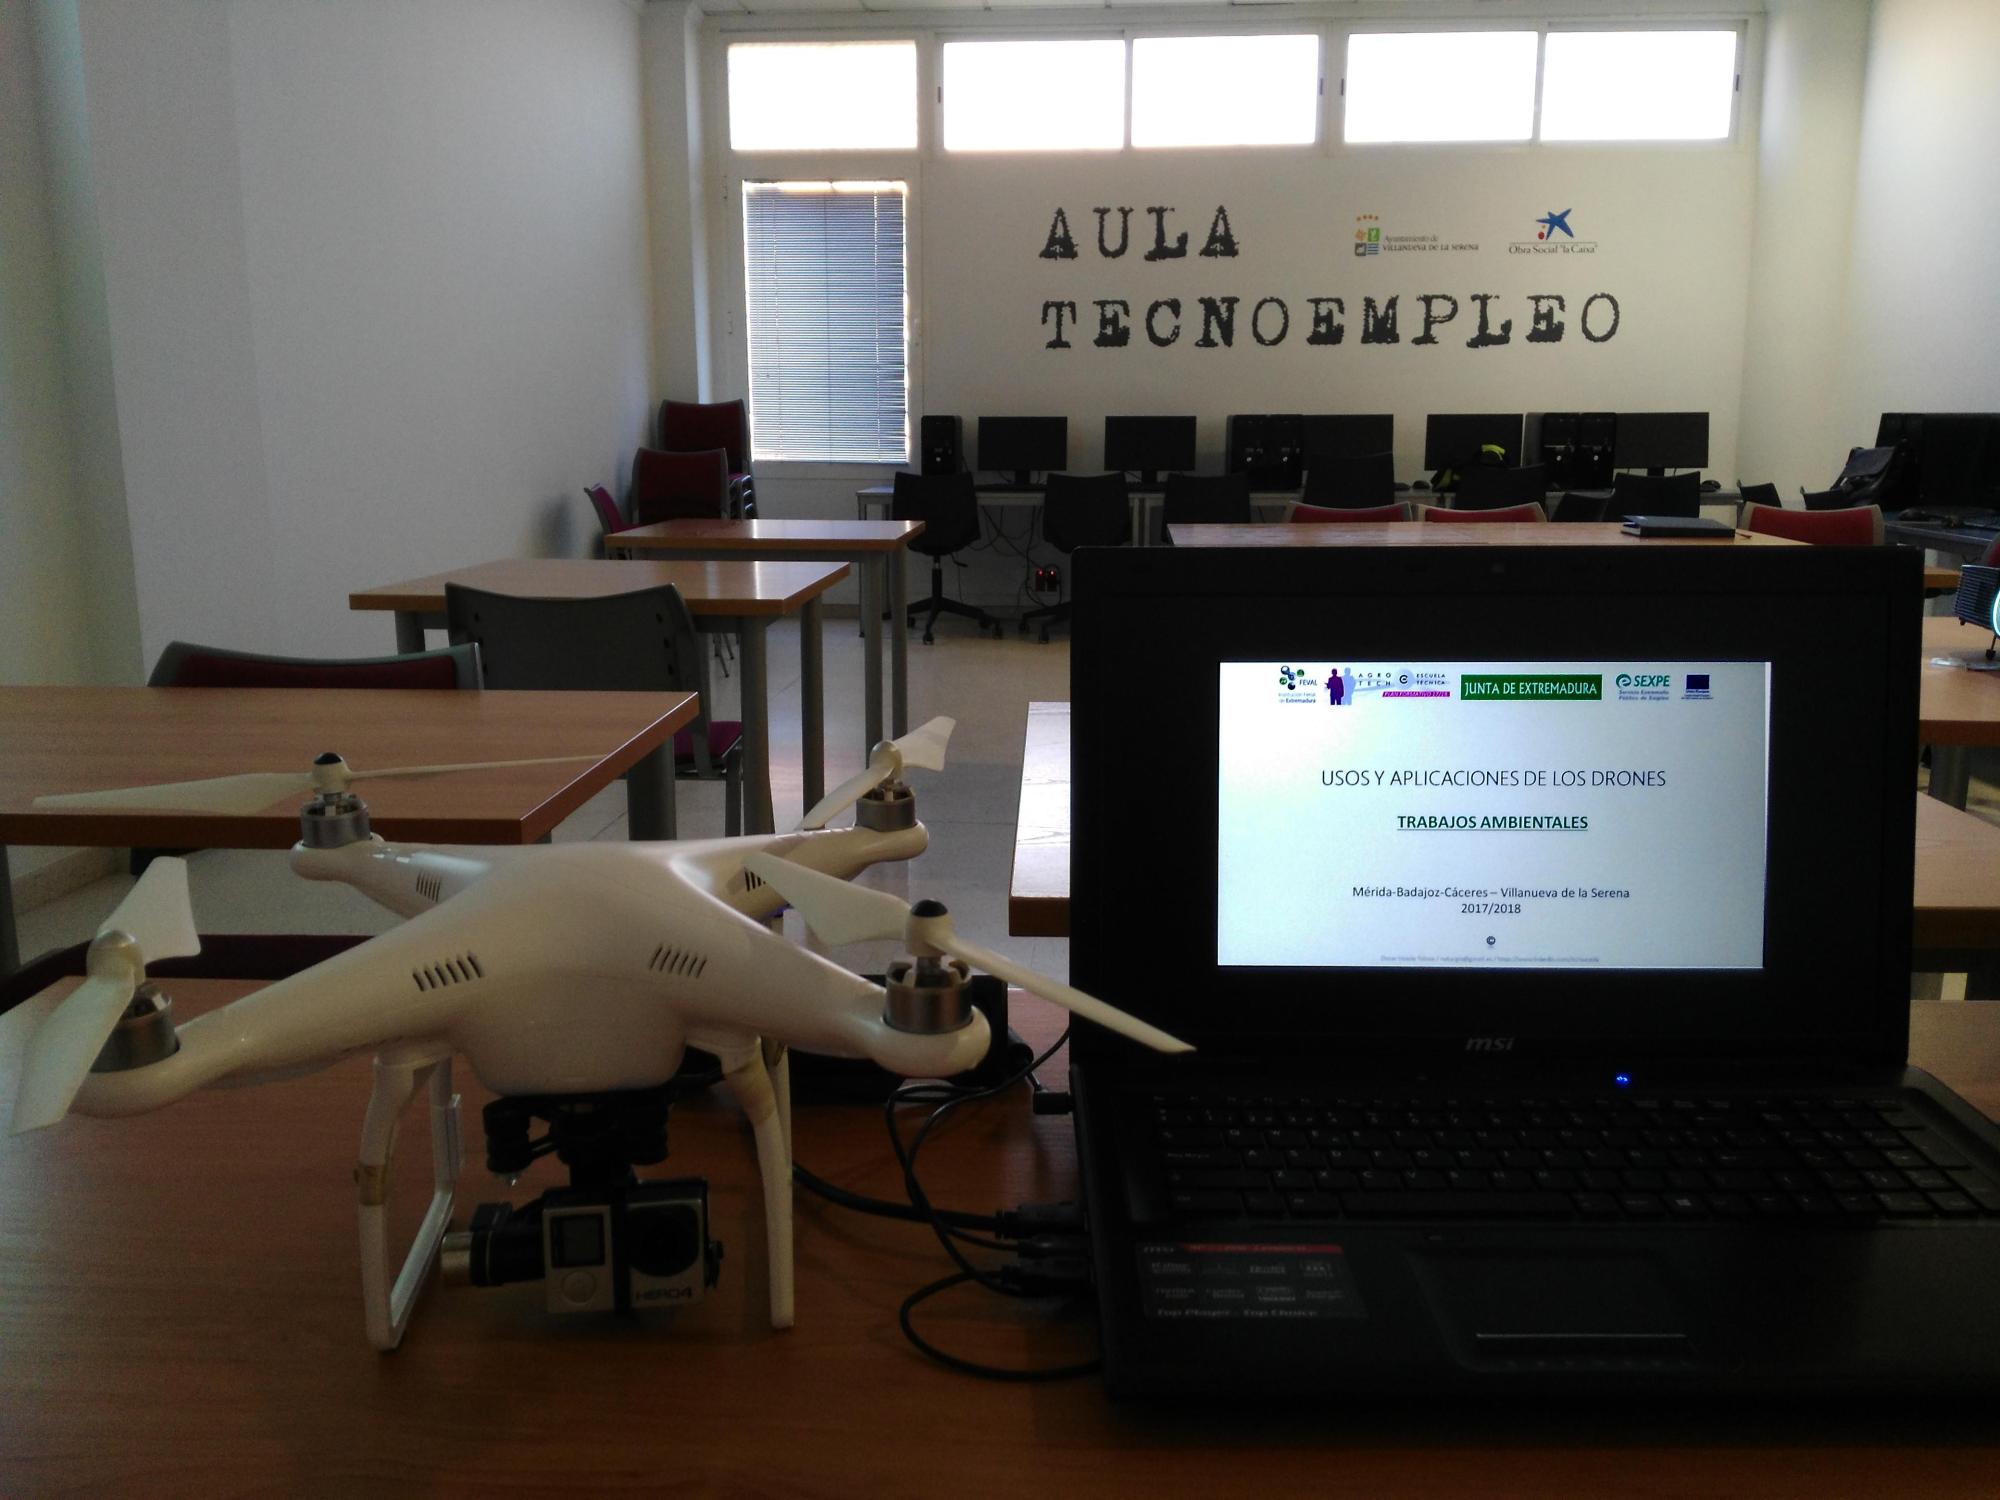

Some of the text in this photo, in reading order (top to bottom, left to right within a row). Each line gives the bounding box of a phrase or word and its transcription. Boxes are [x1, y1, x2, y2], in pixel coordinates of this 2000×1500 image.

[1039, 205, 1239, 260] AULA
[1508, 244, 1532, 254] Obra
[1532, 244, 1558, 254] Social
[1041, 292, 1620, 349] TECNOEMPLEO
[1299, 679, 1318, 687] FEVAL
[1633, 675, 1671, 687] SEXPE
[1465, 682, 1597, 696] JUNTA DE EXTREMADURA
[1321, 770, 1666, 787] USOS Y APLICACIONES DE LOS DRONES
[1397, 815, 1588, 831] TRABAJOS AMBIENTALES
[1352, 886, 1488, 899] Mérida-Badajoz-Cáceres
[1500, 887, 1558, 899] Villanueva
[1561, 887, 1575, 899] de
[1578, 887, 1588, 899] la
[1591, 888, 1630, 899] Serena
[1460, 903, 1522, 916] 2017/2018
[1464, 1036, 1517, 1052] msi
[635, 1286, 693, 1300] HERO4
